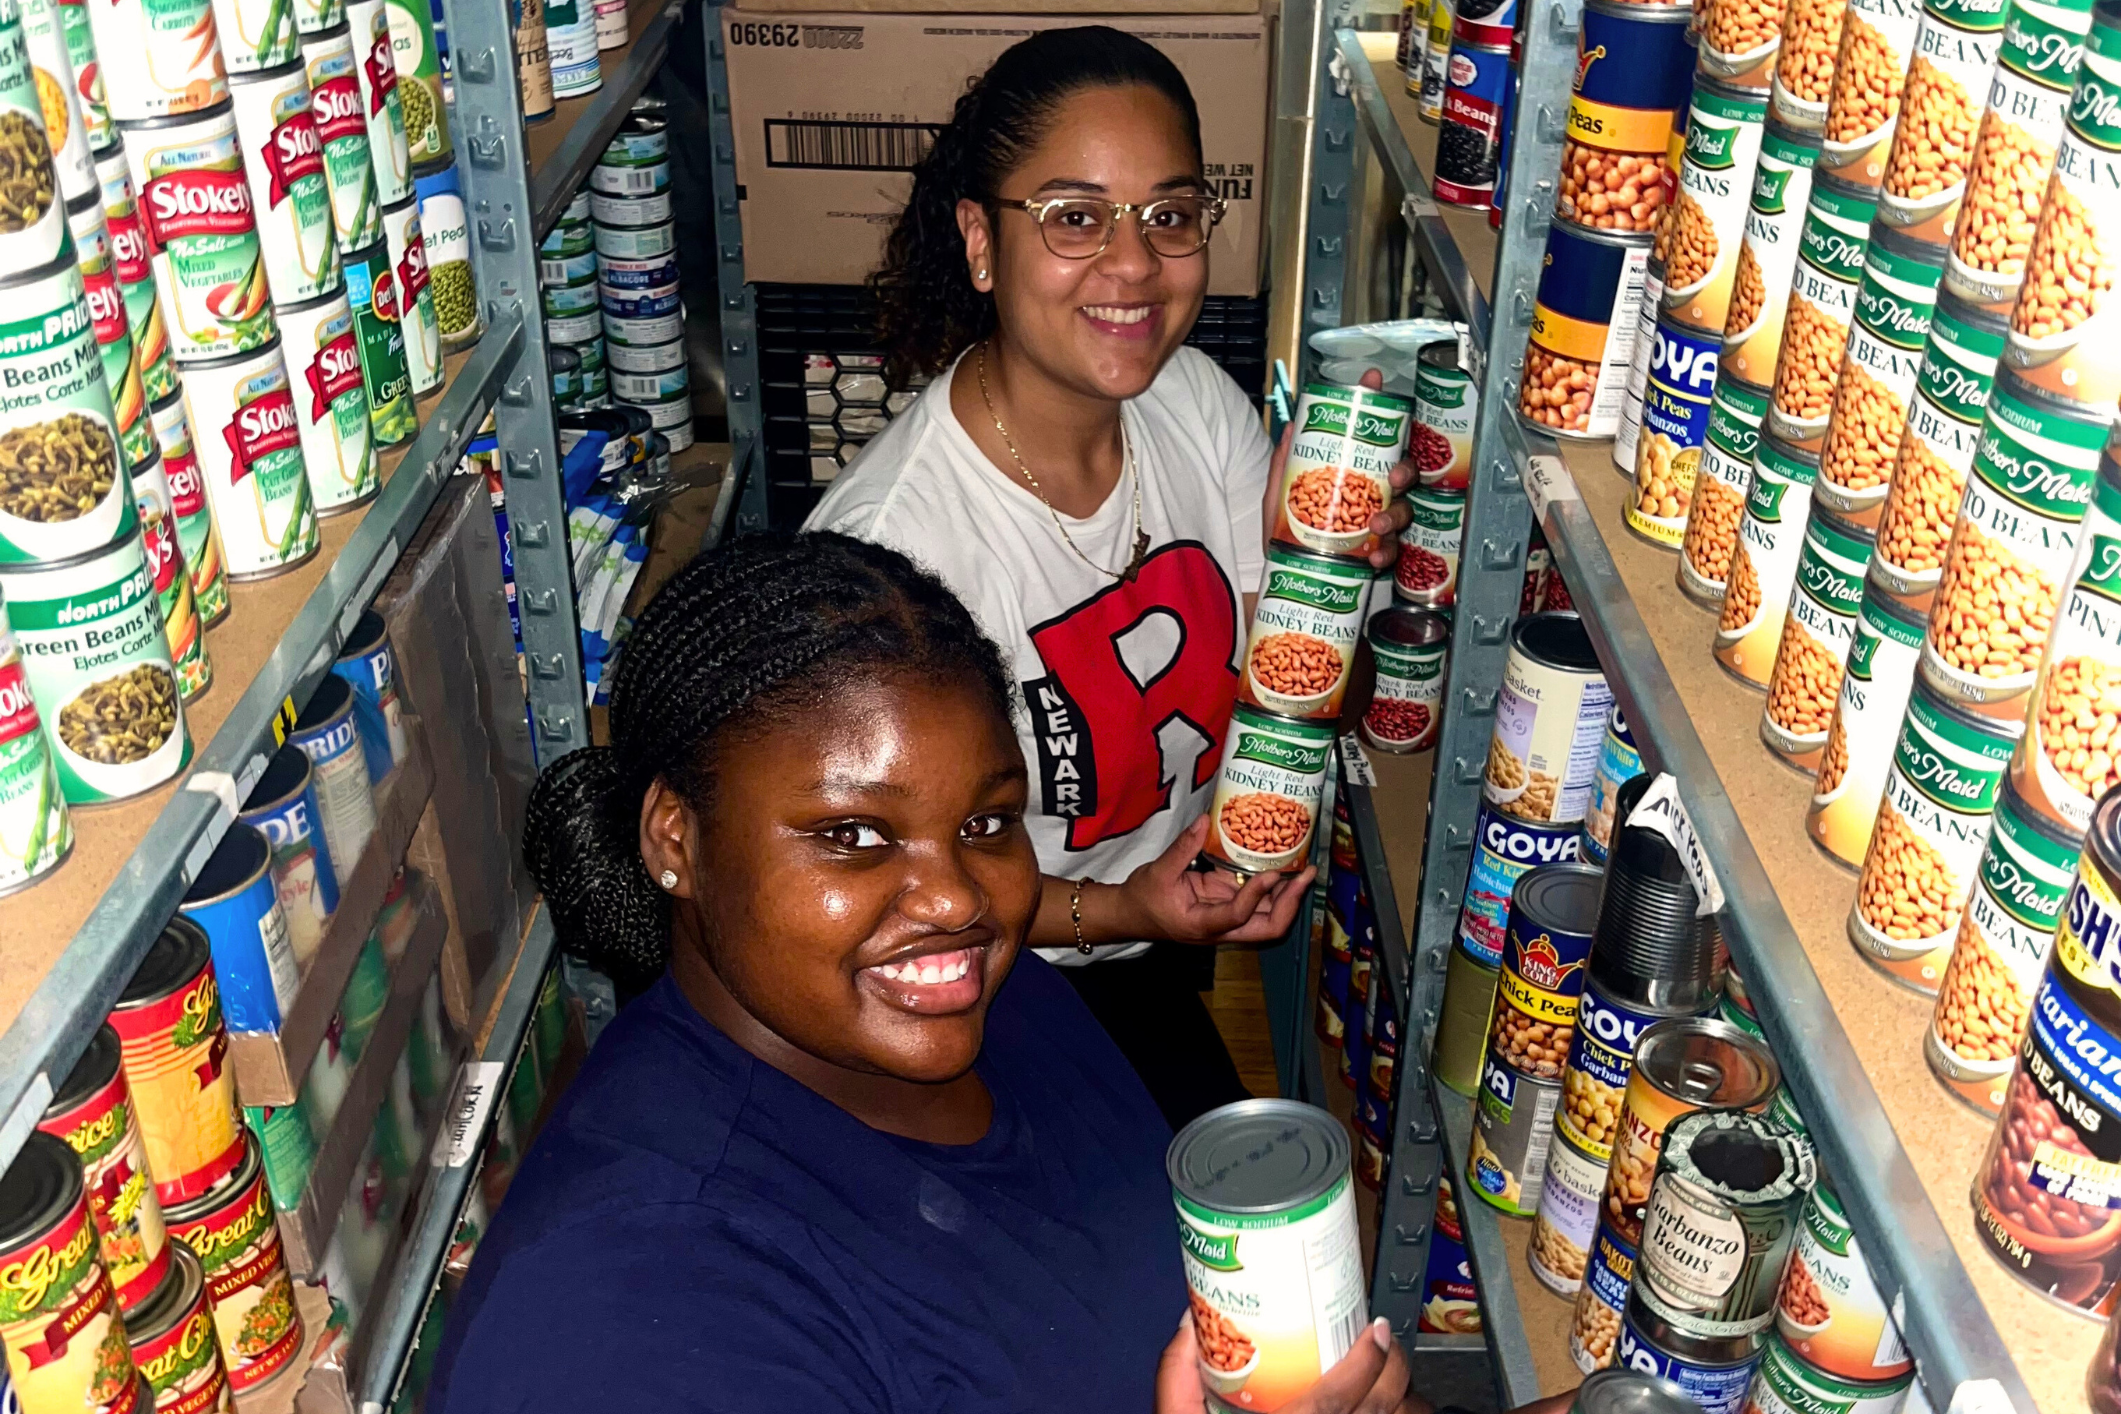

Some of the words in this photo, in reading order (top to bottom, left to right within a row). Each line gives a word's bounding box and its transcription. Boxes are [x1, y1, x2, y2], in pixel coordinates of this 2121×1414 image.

[730, 22, 799, 47] 29390
[1454, 98, 1497, 127] Beans
[1568, 105, 1604, 135] Peas
[1722, 107, 1745, 119] LOW
[328, 141, 346, 159] No
[1687, 124, 1726, 156] Maid
[1778, 148, 1798, 163] LOW
[1229, 164, 1253, 177] NET
[293, 181, 309, 199] No
[171, 239, 198, 258] No
[199, 234, 226, 255] Salt
[177, 259, 215, 277] MIXED
[182, 268, 243, 288] VEGETABLES
[367, 326, 394, 346] MADE
[4, 354, 72, 389] Beans
[1650, 331, 1718, 391] OYA
[45, 375, 84, 402] Corte
[1427, 406, 1445, 417] Red
[1662, 395, 1692, 421] Peas
[1724, 393, 1755, 414] SODIUM
[1357, 420, 1397, 438] Maid
[1427, 416, 1469, 430] BEANS
[1999, 404, 2043, 434] SODIUM
[1355, 445, 1377, 457] Red
[257, 459, 275, 475] No
[1774, 461, 1794, 478] LOW
[261, 474, 281, 489] CUT
[264, 485, 293, 502] BEANS
[1422, 529, 1440, 541] Red
[1286, 560, 1300, 568] LOW
[1302, 563, 1331, 574] SODIUM
[1270, 575, 1323, 605] Mother's
[1321, 588, 1356, 606] Maid
[58, 595, 120, 625] NORTH
[1279, 604, 1312, 621] Light
[1314, 610, 1335, 623] Red
[1869, 611, 1887, 631] LOW
[85, 615, 144, 649] Beans
[1256, 609, 1308, 632] KIDNEY
[1312, 623, 1357, 639] BEANS
[73, 649, 119, 671] Ejotes
[121, 631, 153, 657] Corte
[1377, 676, 1402, 690] Dark
[1405, 681, 1425, 690] Red
[1258, 723, 1273, 731] LOW
[1274, 727, 1302, 737] SODIUM
[1038, 685, 1081, 817] NEWARK
[1239, 738, 1293, 767] Mother's
[1292, 751, 1324, 769] Maid
[1225, 768, 1279, 792] KIDNEY
[1283, 783, 1323, 798] BEANS
[1250, 765, 1283, 783] Light
[1285, 771, 1304, 784] Red
[1911, 752, 1987, 800] Maid
[1486, 822, 1580, 862] GOYA
[1483, 853, 1501, 873] Red
[1989, 862, 2065, 917] Maid
[1523, 966, 1556, 988] COLE
[1524, 956, 1557, 977] KING
[1500, 969, 1535, 1008] Chick
[1540, 998, 1576, 1019] Pea
[1582, 1039, 1616, 1068] Chick
[1580, 1052, 1628, 1087] Garban
[2030, 1054, 2102, 1134] BEANS
[1481, 1157, 1500, 1173] Now
[1560, 1187, 1585, 1207] PEAS
[182, 1205, 255, 1256] Great
[1213, 1216, 1238, 1229] LOW
[1242, 1215, 1289, 1230] SODIUM
[1651, 1187, 1740, 1257] Garbanzo
[1805, 1206, 1843, 1244] Maid
[1182, 1224, 1228, 1261] Maid
[1600, 1235, 1634, 1273] DAKOT
[1653, 1222, 1714, 1275] Beans
[2006, 1236, 2023, 1257] 794
[2022, 1252, 2032, 1268] g
[213, 1265, 258, 1296] MIXED
[62, 1286, 103, 1334] MIXED
[1837, 1388, 1862, 1399] LOW
